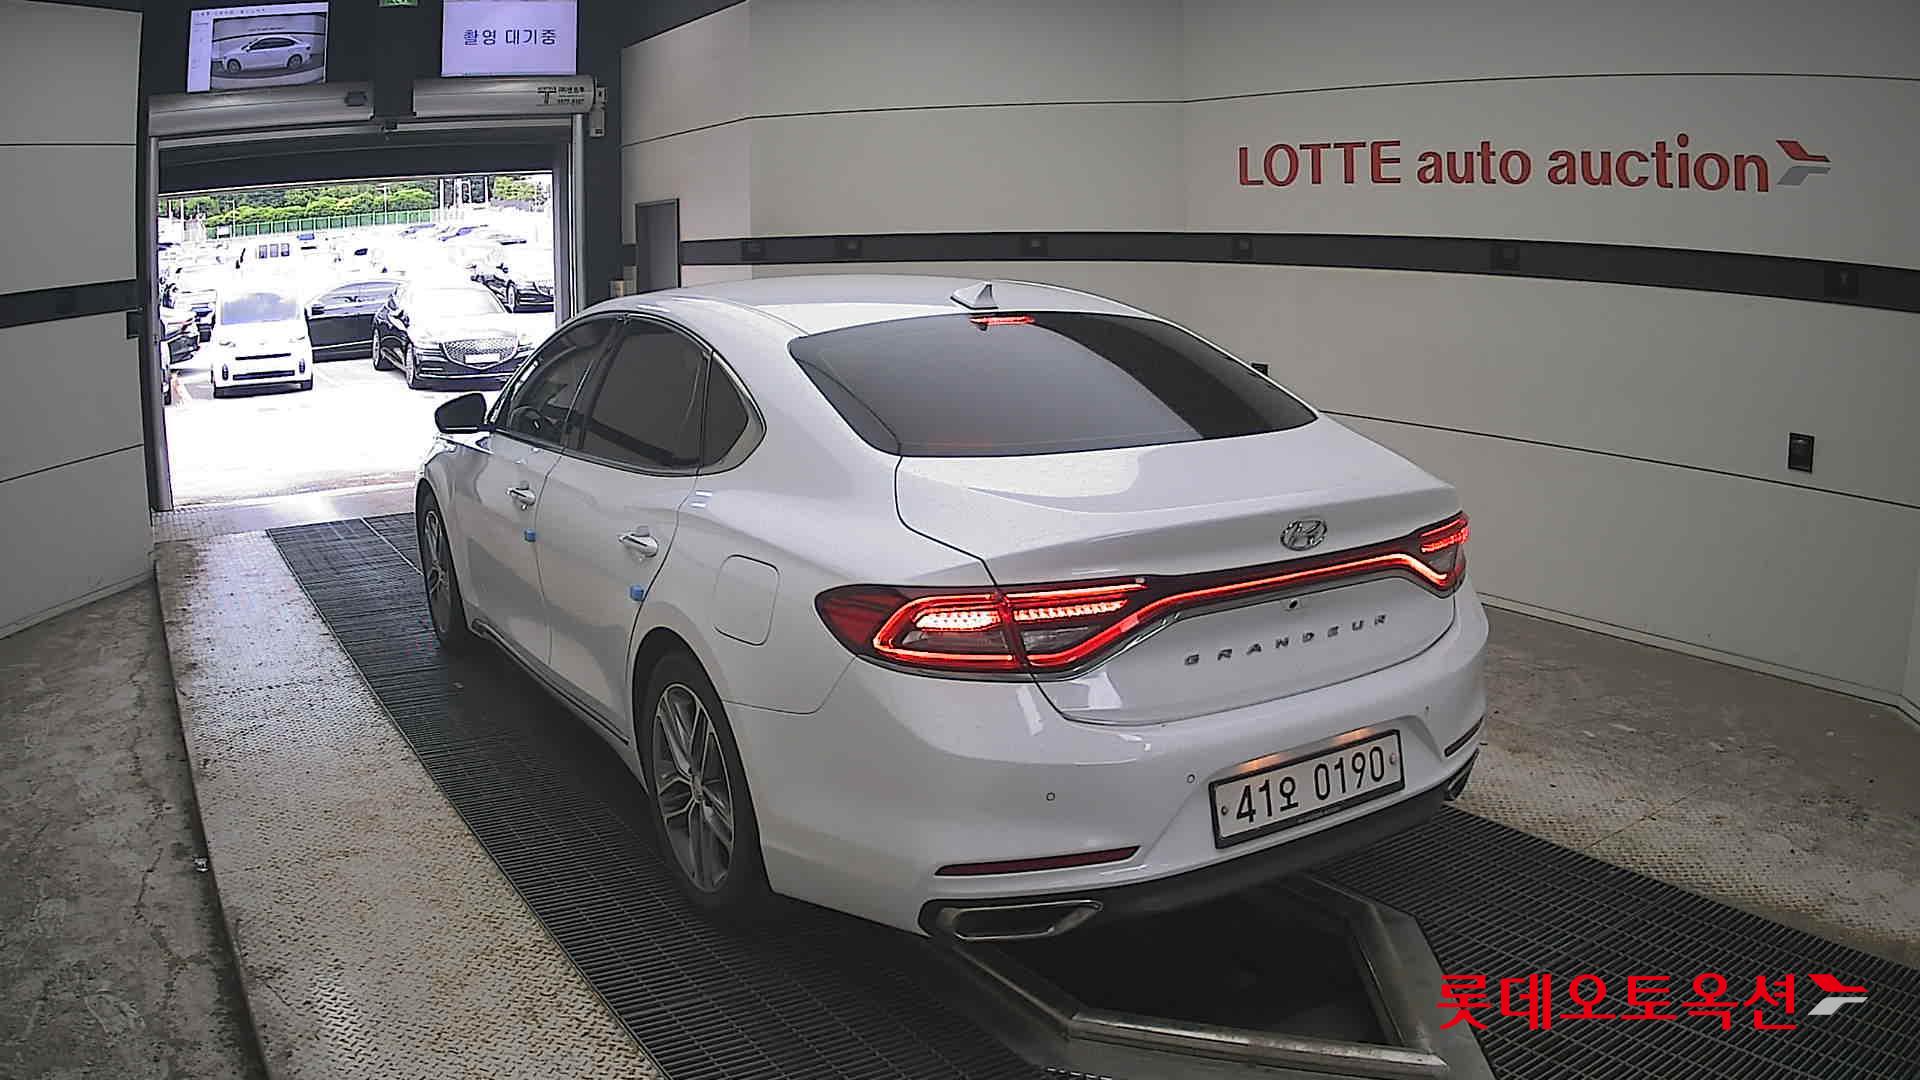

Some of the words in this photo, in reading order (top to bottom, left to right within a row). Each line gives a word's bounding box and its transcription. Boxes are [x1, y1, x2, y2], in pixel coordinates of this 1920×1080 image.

[464, 29, 496, 46] 촬영
[505, 29, 556, 45] 대기중
[1238, 140, 1400, 187] LOTTE
[1416, 141, 1532, 186] auto
[1547, 133, 1770, 193] auction
[1184, 614, 1386, 666] GRANDEUR
[1236, 776, 1299, 823] 41오
[1314, 746, 1385, 801] 0190
